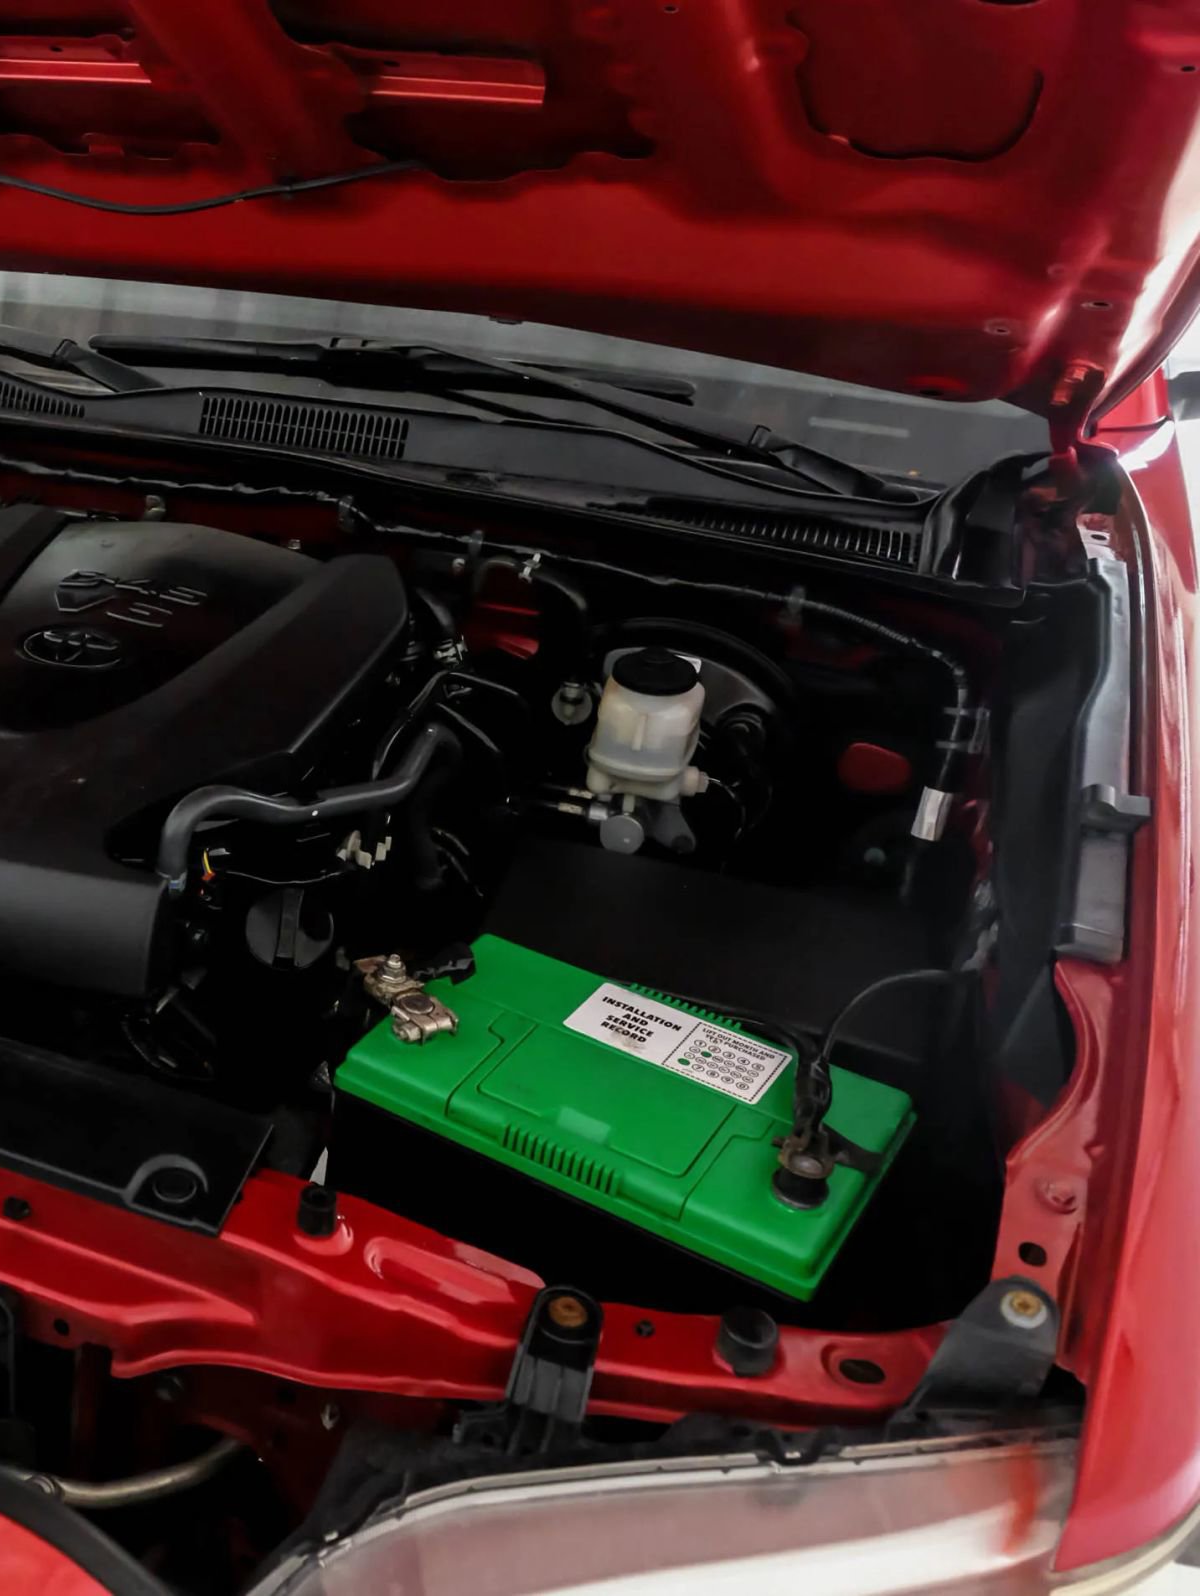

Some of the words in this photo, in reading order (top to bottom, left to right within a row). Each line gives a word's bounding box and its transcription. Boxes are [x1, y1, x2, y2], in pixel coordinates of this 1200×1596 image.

[602, 996, 682, 1031] INSTALLATION
[622, 1013, 649, 1026] AND
[600, 1021, 647, 1043] RECORD
[606, 1015, 654, 1037] SERVICE
[702, 1027, 717, 1036] LIFT
[717, 1033, 732, 1041] OUT
[732, 1039, 758, 1053] MONTH
[759, 1050, 775, 1059] AND
[724, 1042, 766, 1060] PURCHASED
